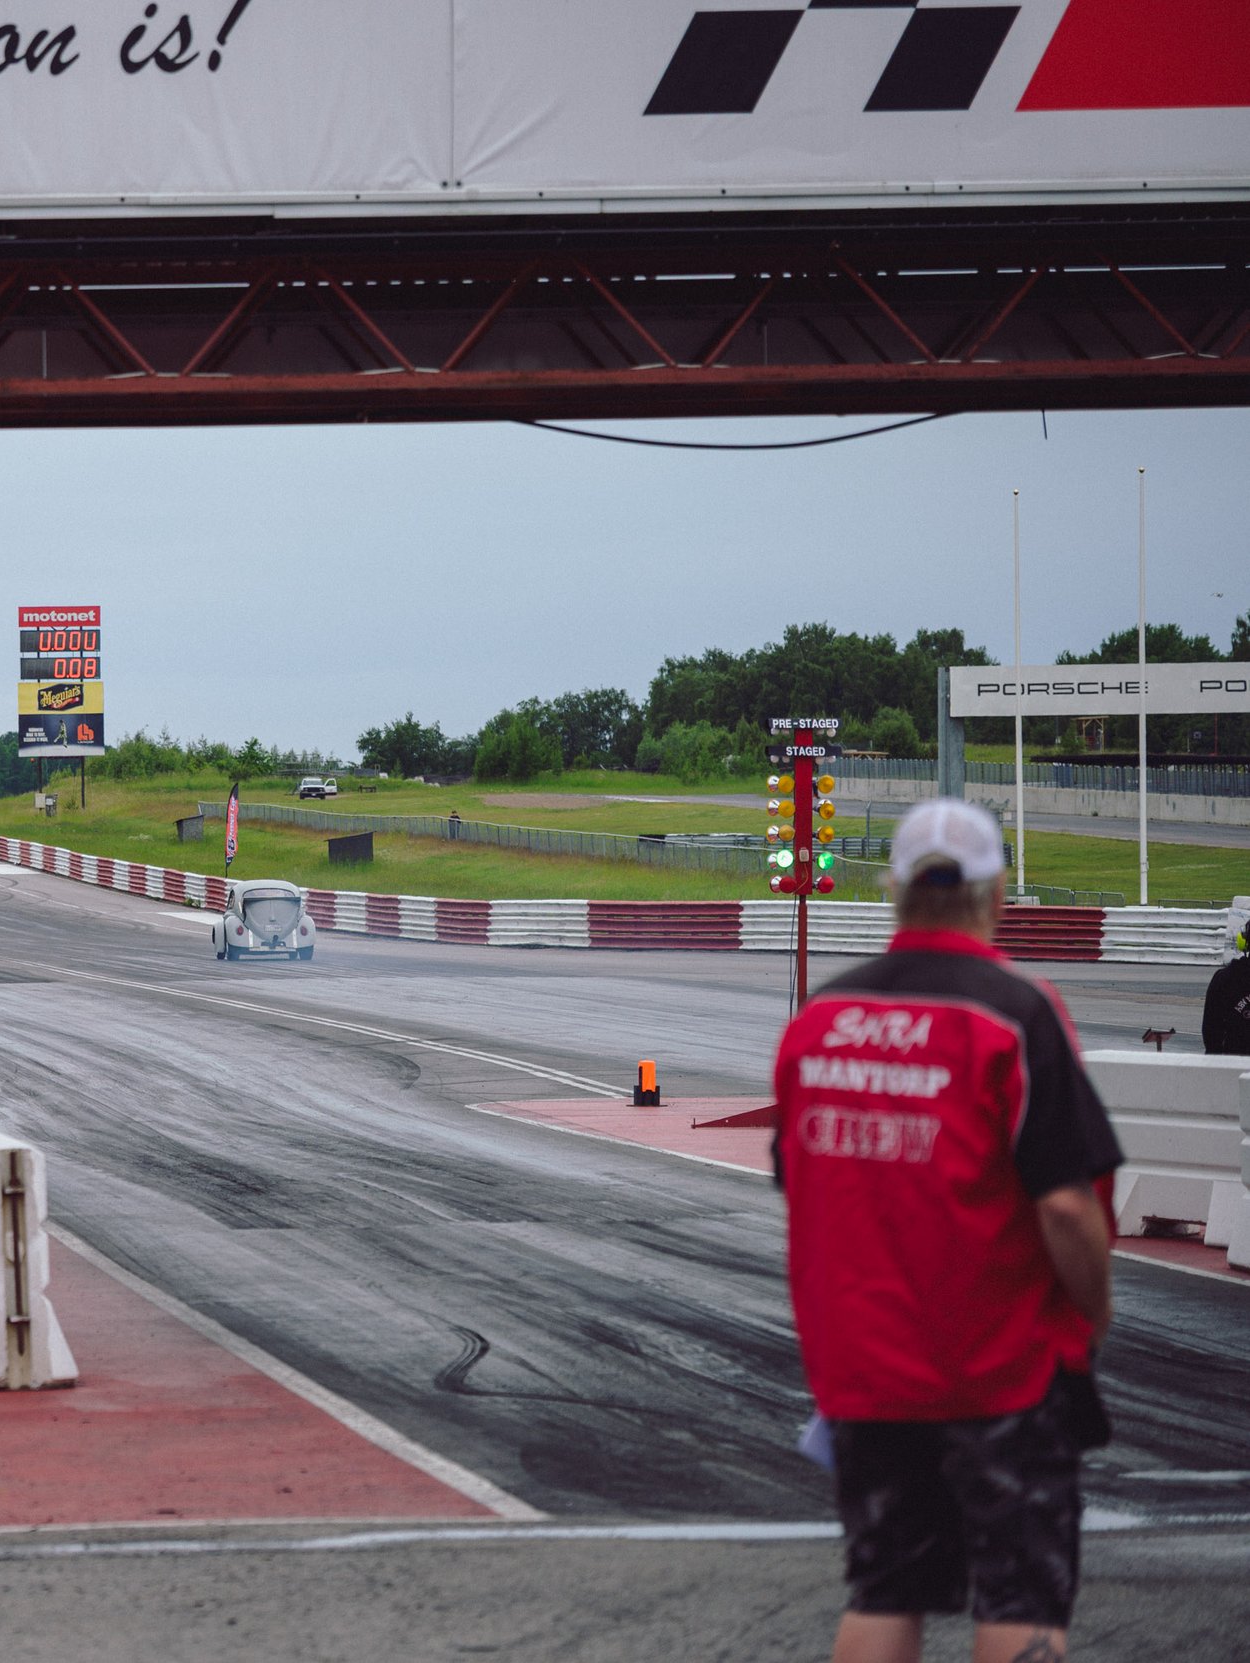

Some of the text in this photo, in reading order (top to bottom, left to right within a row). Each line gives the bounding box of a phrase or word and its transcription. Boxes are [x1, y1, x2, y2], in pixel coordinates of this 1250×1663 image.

[119, 0, 251, 75] is!
[23, 609, 96, 622] motonet
[977, 681, 1149, 696] PORSCHE
[785, 746, 826, 756] STAGED
